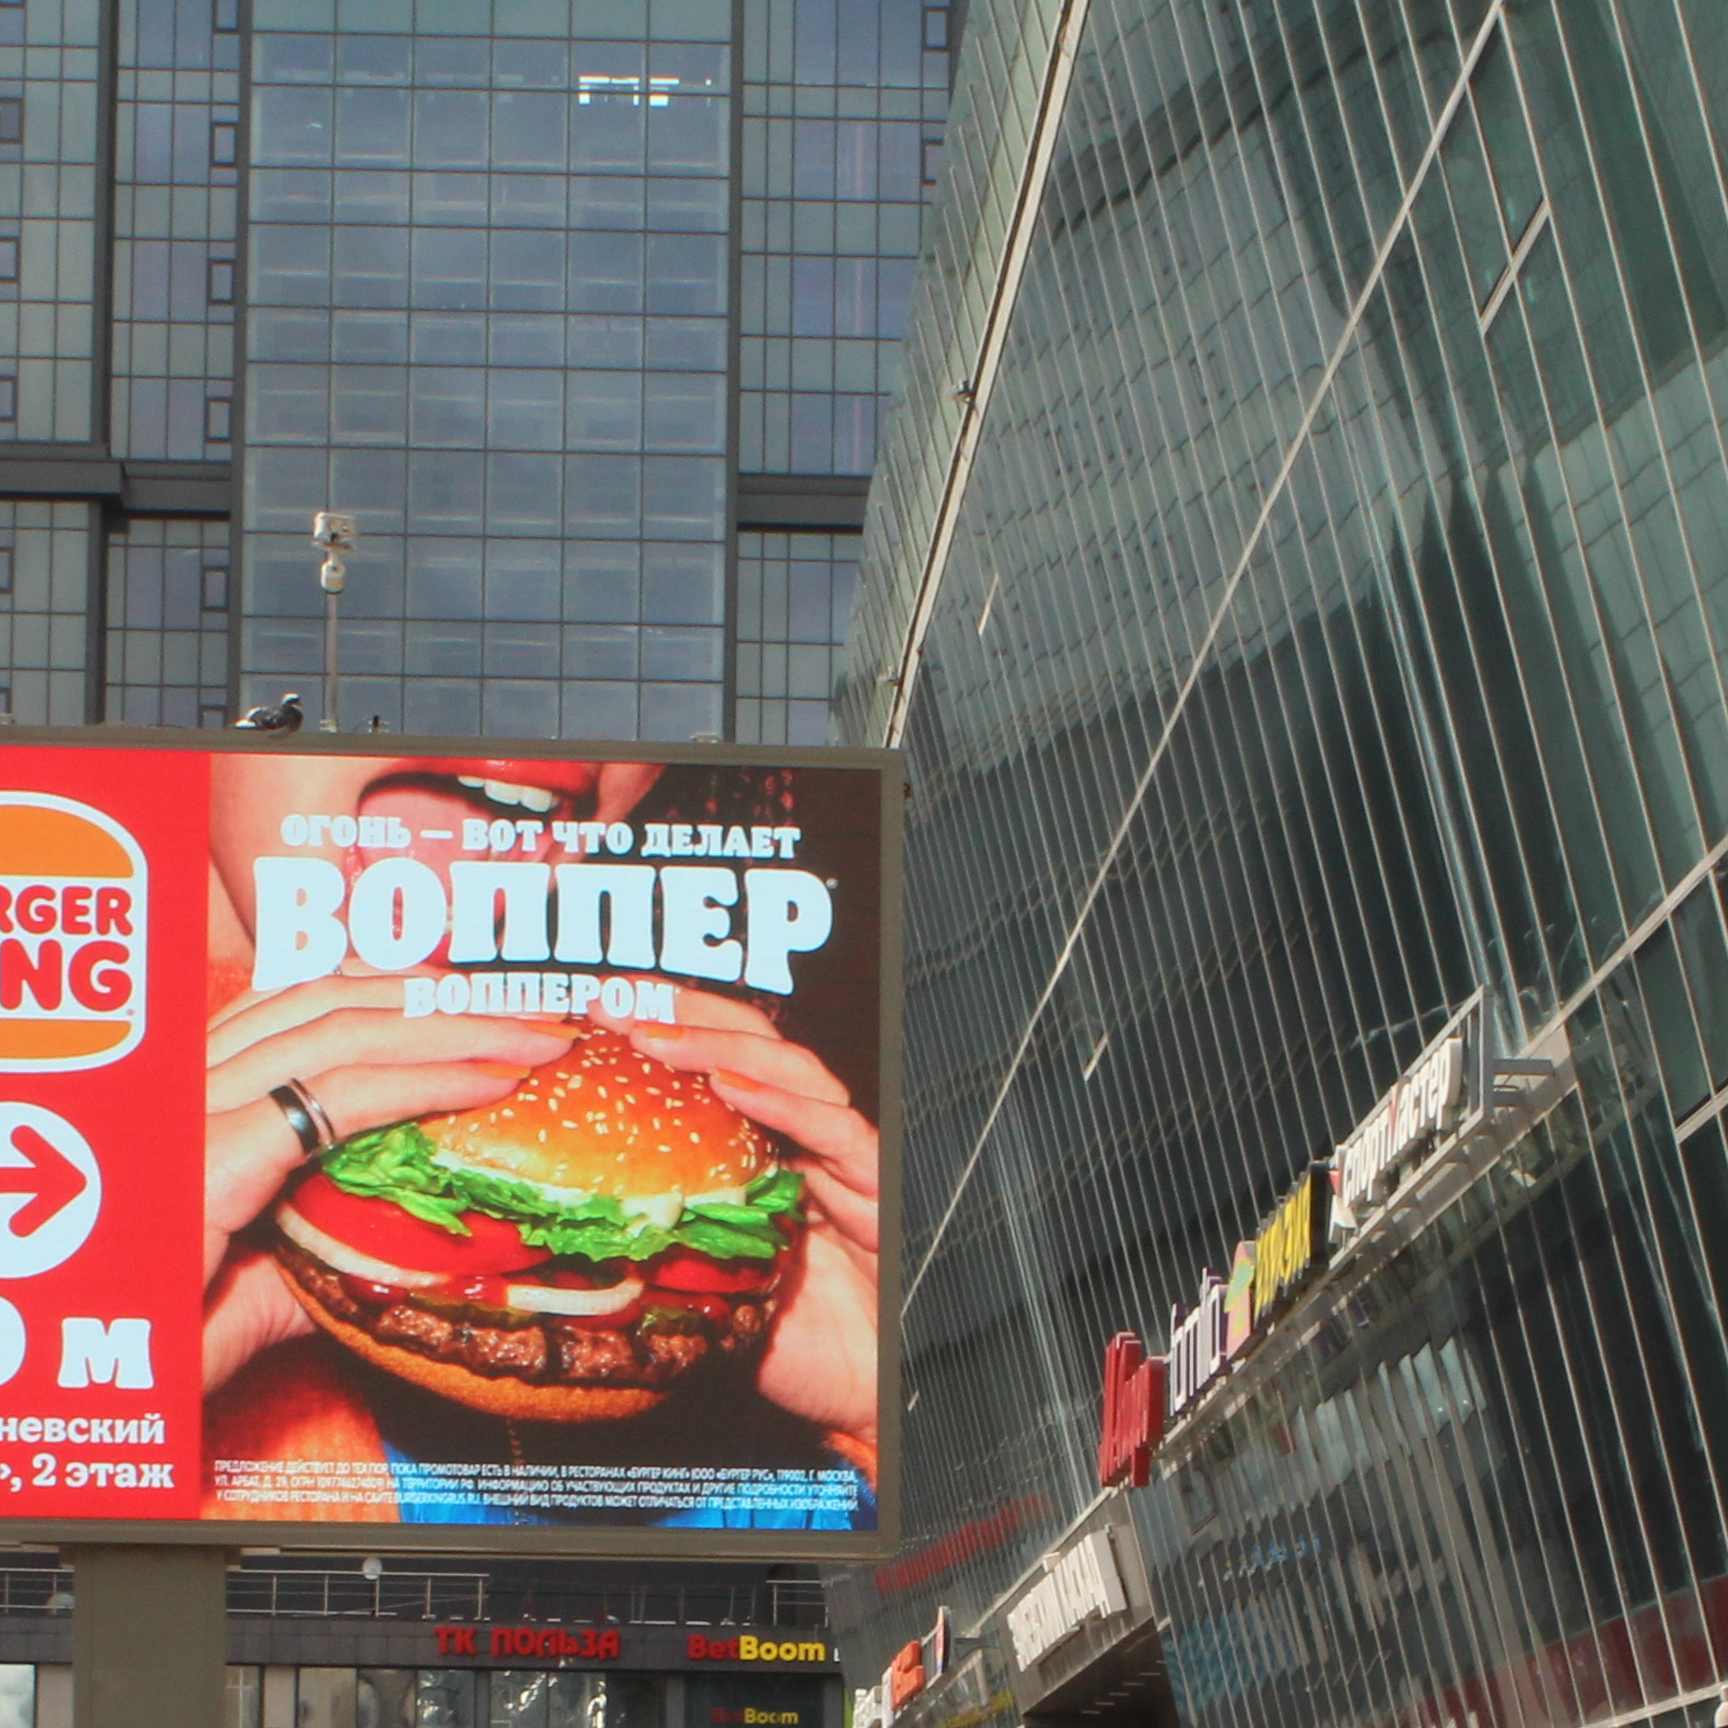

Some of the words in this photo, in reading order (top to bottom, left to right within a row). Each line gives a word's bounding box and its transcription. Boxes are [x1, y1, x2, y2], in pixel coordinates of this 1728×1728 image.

[280, 814, 412, 849] ОГОНЬ
[462, 818, 544, 852] ВОТ
[552, 820, 634, 855] ЧТО
[641, 823, 801, 859] ДЕЛАЕТ
[251, 856, 833, 996] ВОППЕР
[403, 973, 677, 1025] ВОППЕРОМ
[32, 1453, 56, 1487] 2
[65, 1461, 175, 1488] этаж
[391, 1463, 417, 1475] ПОКА
[419, 1463, 480, 1476] ПРОМОТОВАР
[482, 1464, 502, 1476] ЕСТЬ
[504, 1464, 510, 1476] В
[561, 1465, 567, 1477] В
[568, 1466, 625, 1478] РЕСТОРАНАХ
[478, 1479, 549, 1492] ИНФОРМАЦИЮ
[551, 1480, 564, 1492] ОБ
[638, 1482, 690, 1494] ПРОДУКТАХ
[692, 1482, 700, 1493] И
[435, 1627, 476, 1655] ТК
[490, 1627, 621, 1661] ПОЛЬЗА
[687, 1635, 825, 1662] BetBoom
